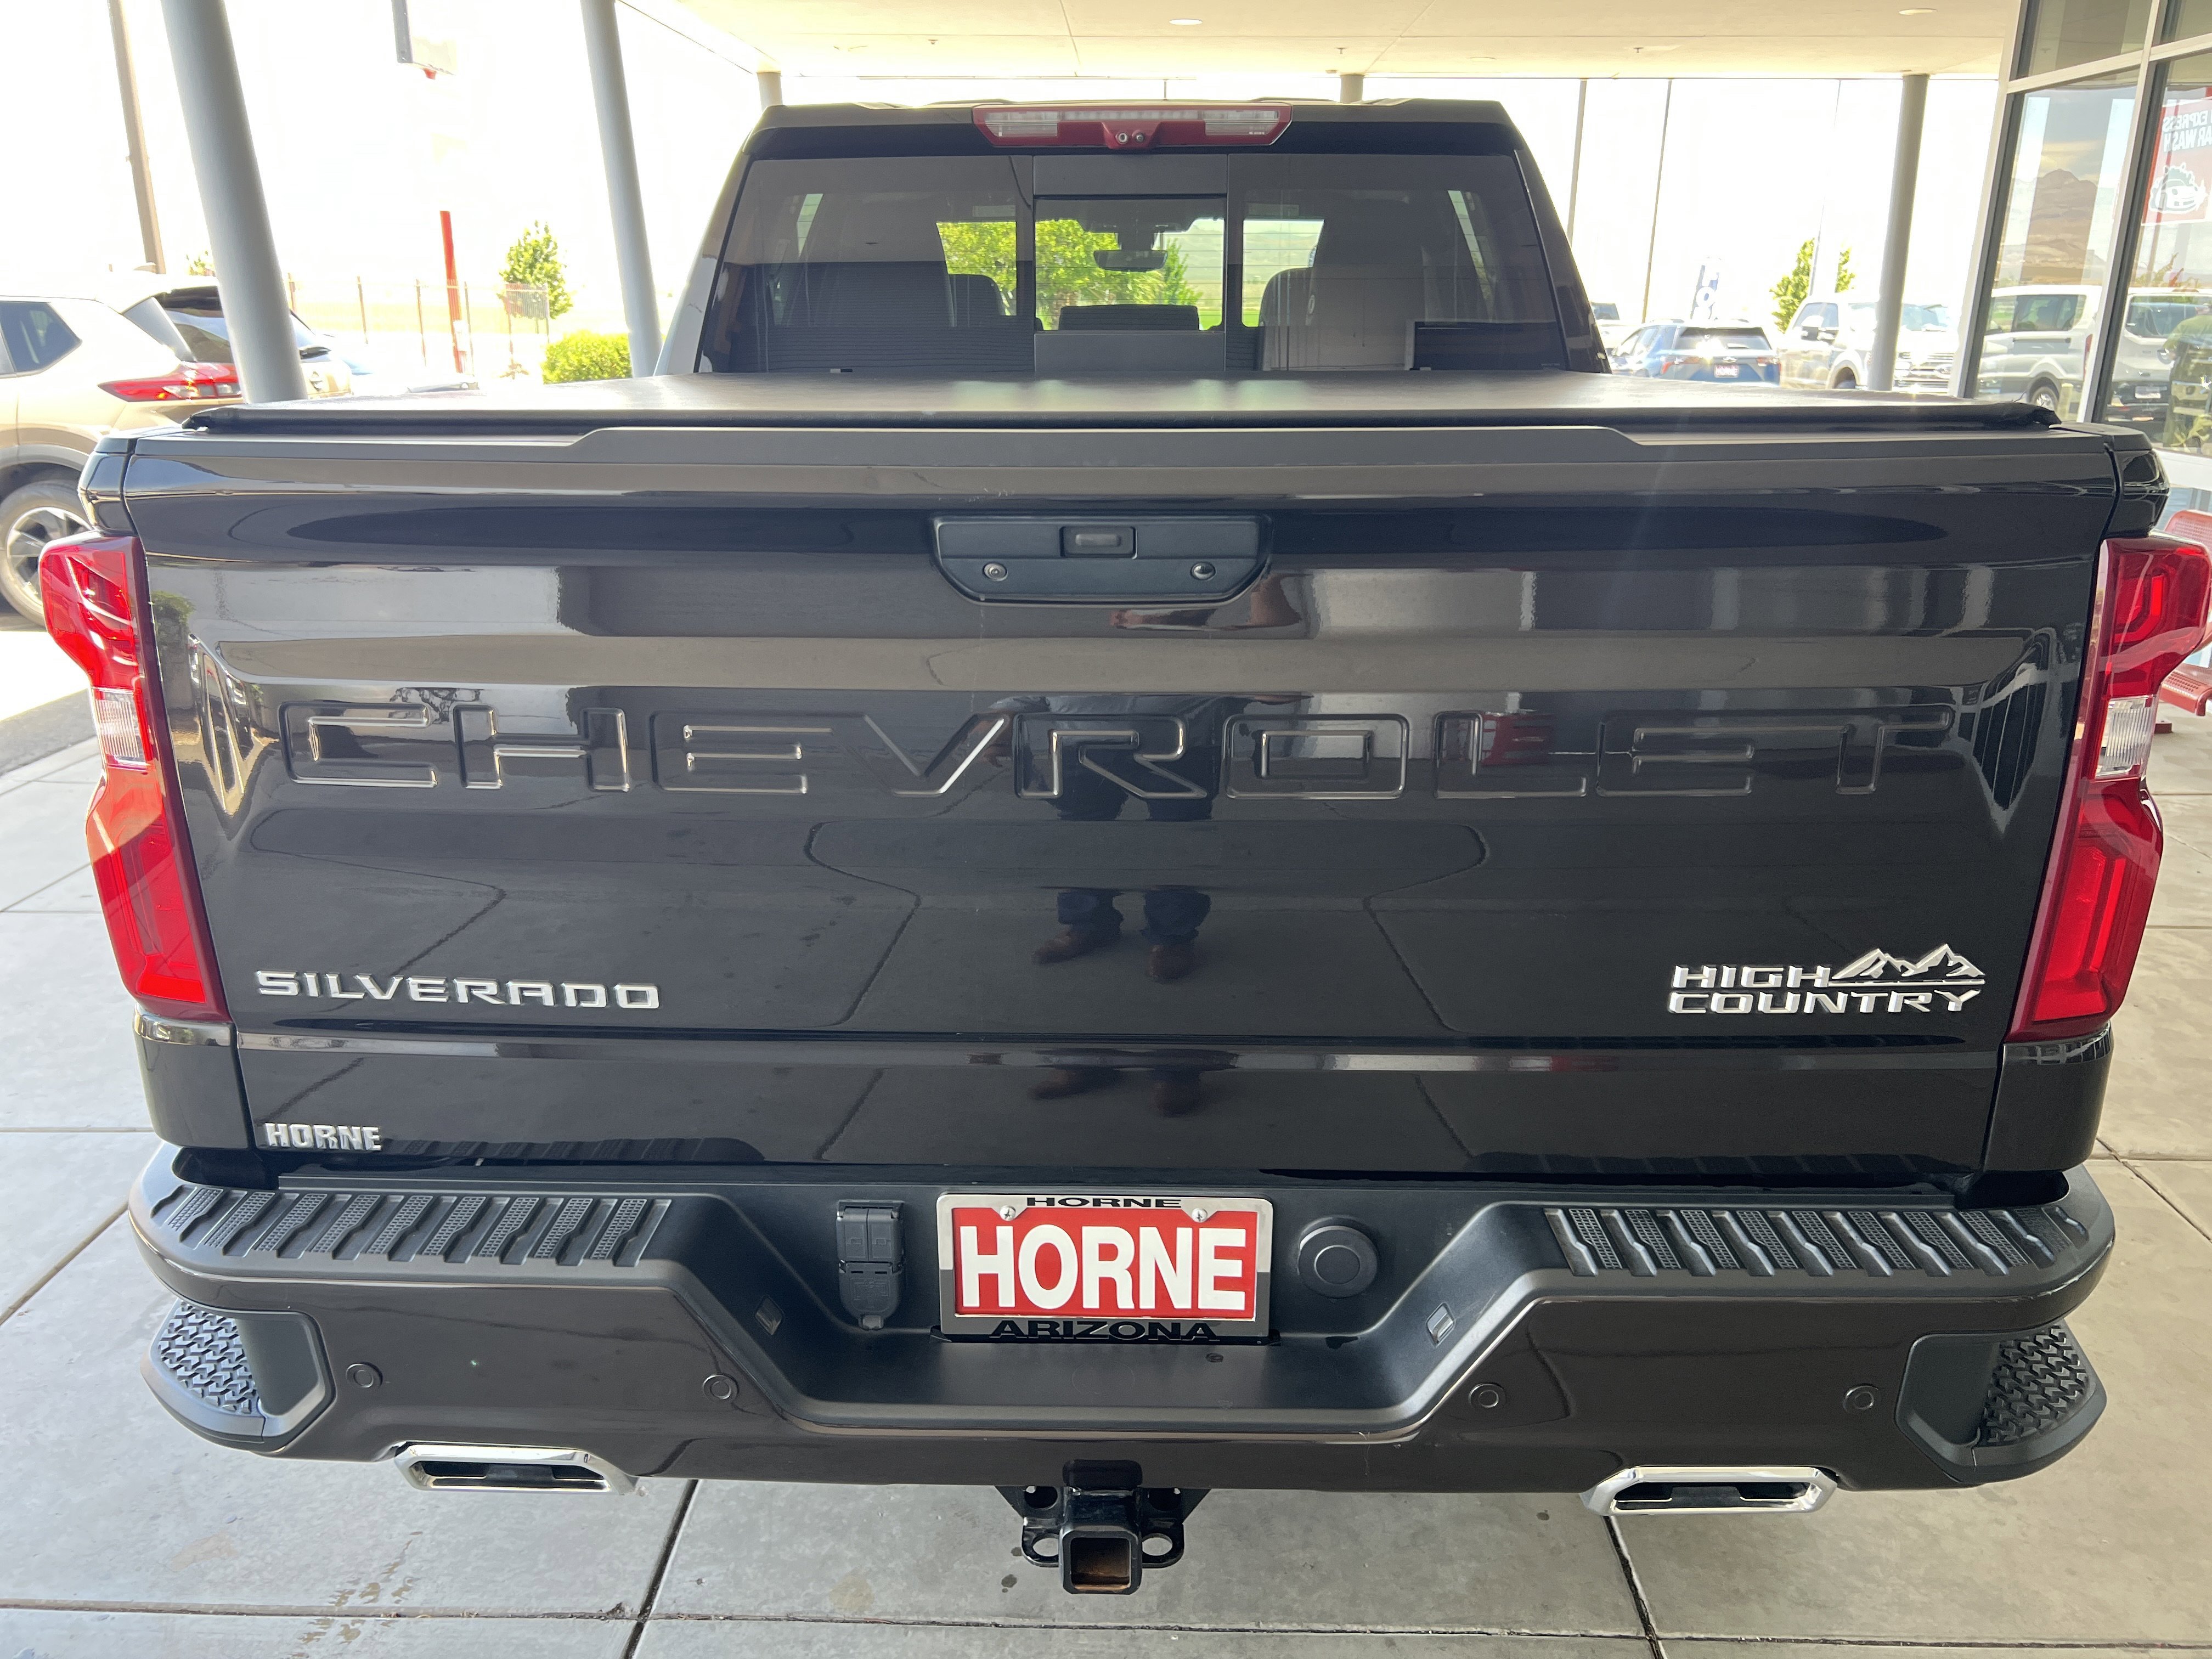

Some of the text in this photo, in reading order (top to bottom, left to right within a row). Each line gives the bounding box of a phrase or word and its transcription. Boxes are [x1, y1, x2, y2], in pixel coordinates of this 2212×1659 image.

[278, 702, 1952, 799] CHEVROLET
[256, 969, 661, 1010] SILVERADO
[1671, 964, 1831, 989] HIGH
[1668, 989, 1982, 1014] COUNTRY
[264, 1122, 382, 1151] HORNE
[1026, 1197, 1182, 1208] HORNE
[959, 1224, 1247, 1311] HORNE
[989, 1320, 1220, 1342] ARIZONA
